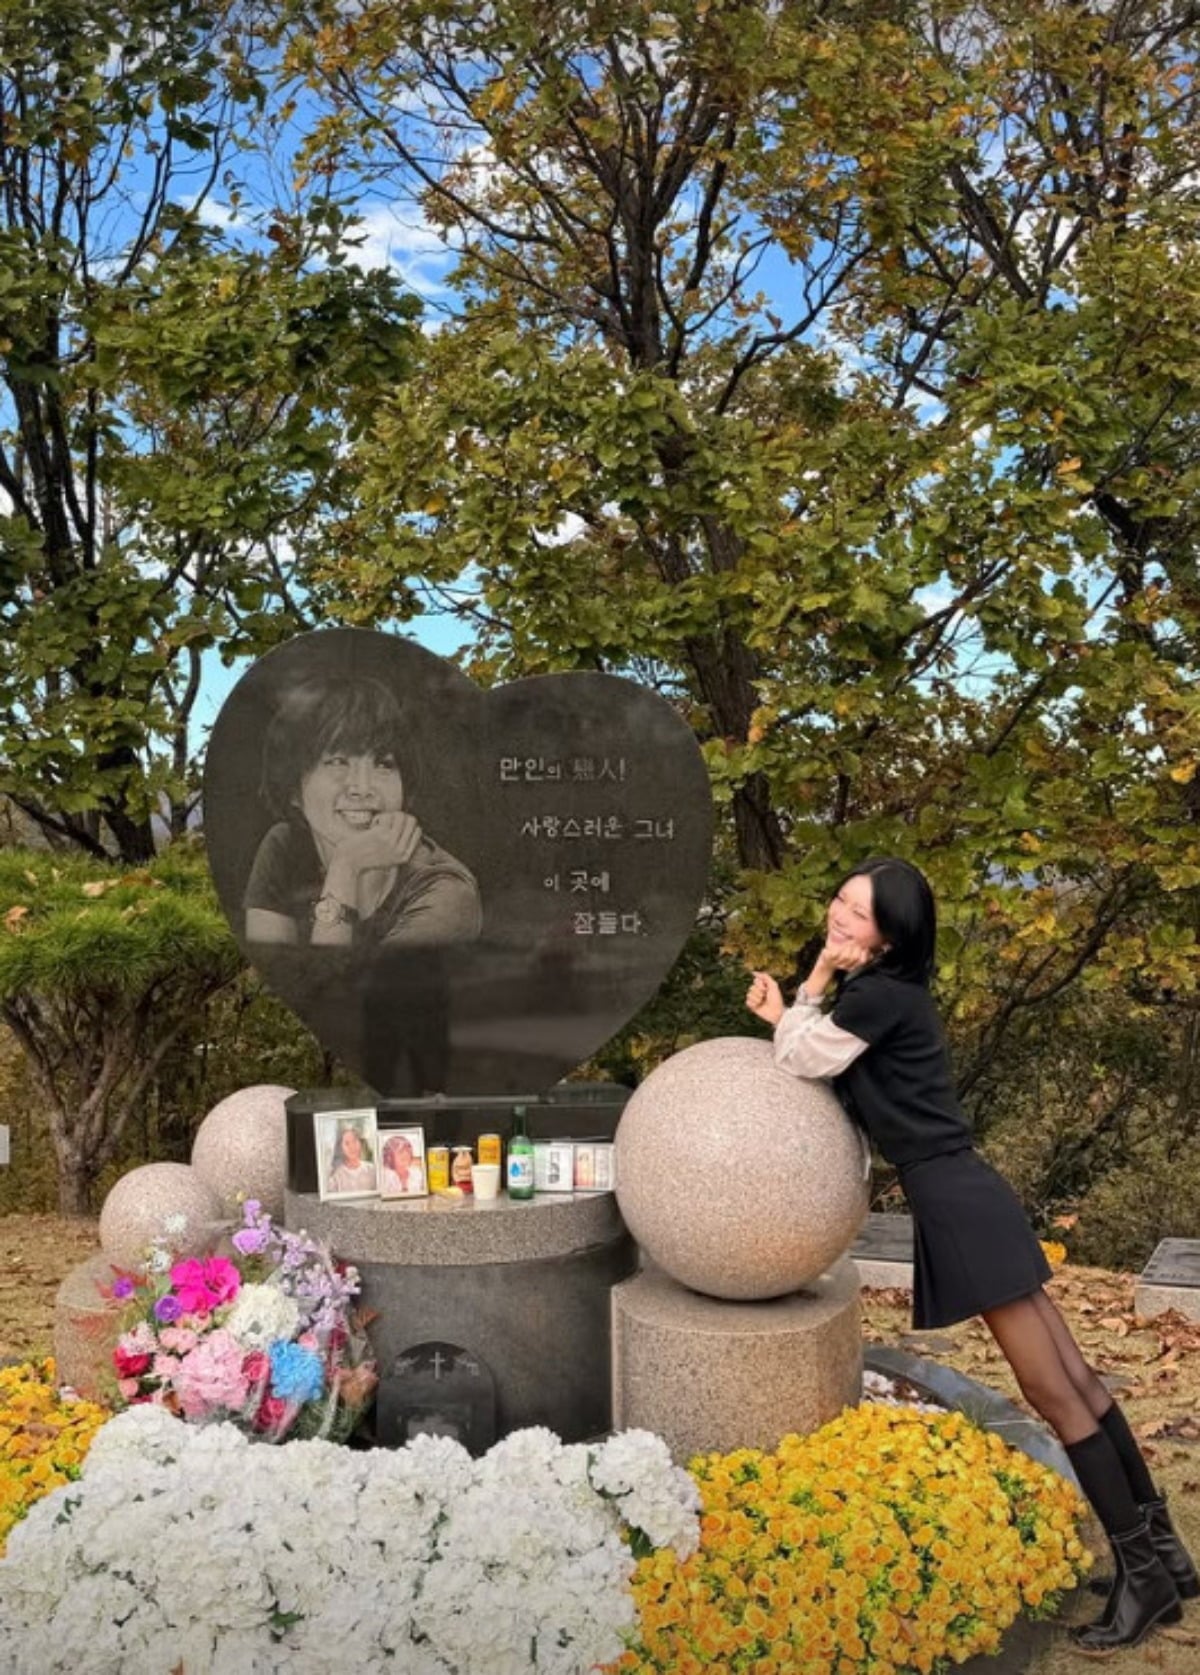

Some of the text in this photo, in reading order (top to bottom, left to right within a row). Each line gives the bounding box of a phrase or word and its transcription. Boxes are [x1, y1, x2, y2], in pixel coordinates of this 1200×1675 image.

[499, 756, 561, 781] 만인의
[520, 815, 675, 839] 사랑스러운 그녀
[543, 870, 610, 893] 이 곳에
[574, 911, 648, 936] 잠들다.
